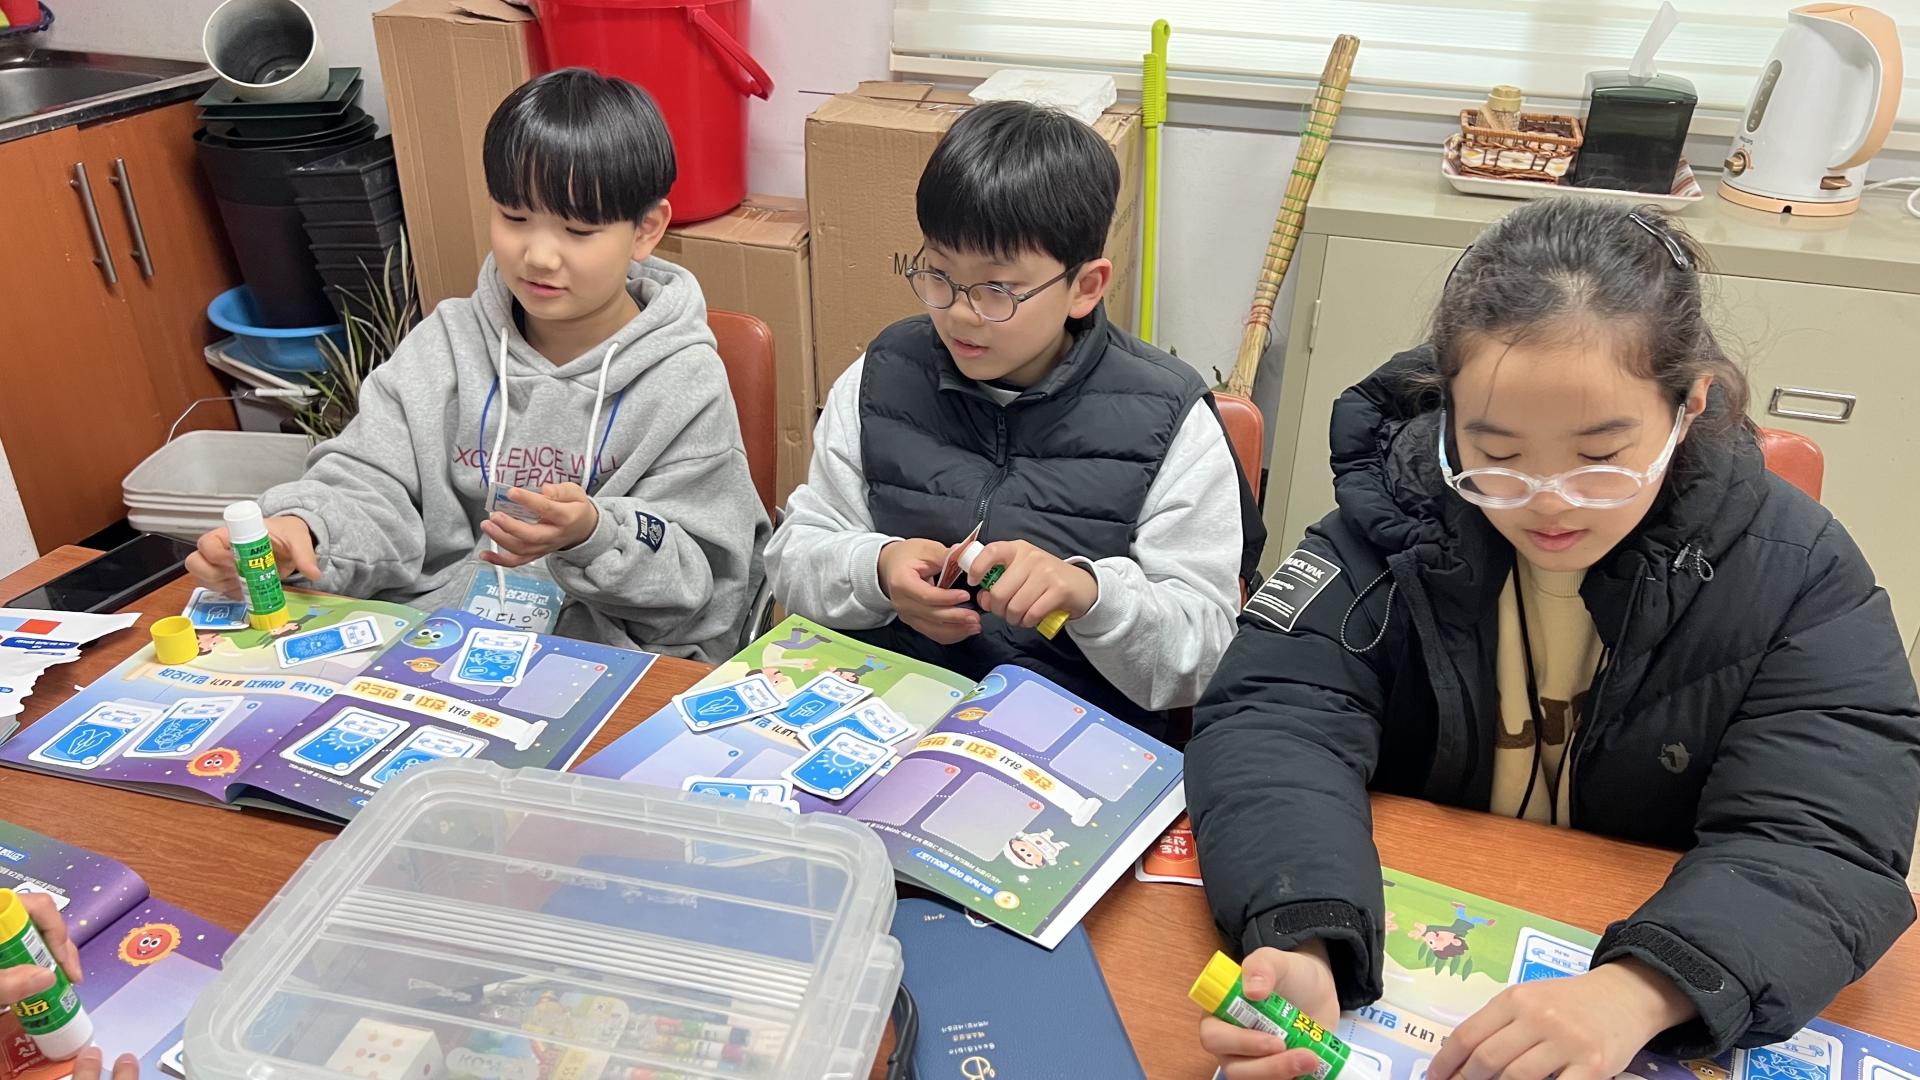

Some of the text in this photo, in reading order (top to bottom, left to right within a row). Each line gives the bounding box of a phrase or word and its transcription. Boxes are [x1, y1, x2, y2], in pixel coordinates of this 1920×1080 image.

[243, 679, 286, 690] 아버지
[289, 681, 335, 698] 하나님
[416, 695, 449, 713] 천지
[448, 705, 471, 718] 하사
[468, 711, 501, 728] 전능
[965, 742, 998, 760] 천지
[999, 754, 1023, 771] 하사
[1022, 768, 1055, 791] 전능
[1403, 1022, 1434, 1043] 내가
